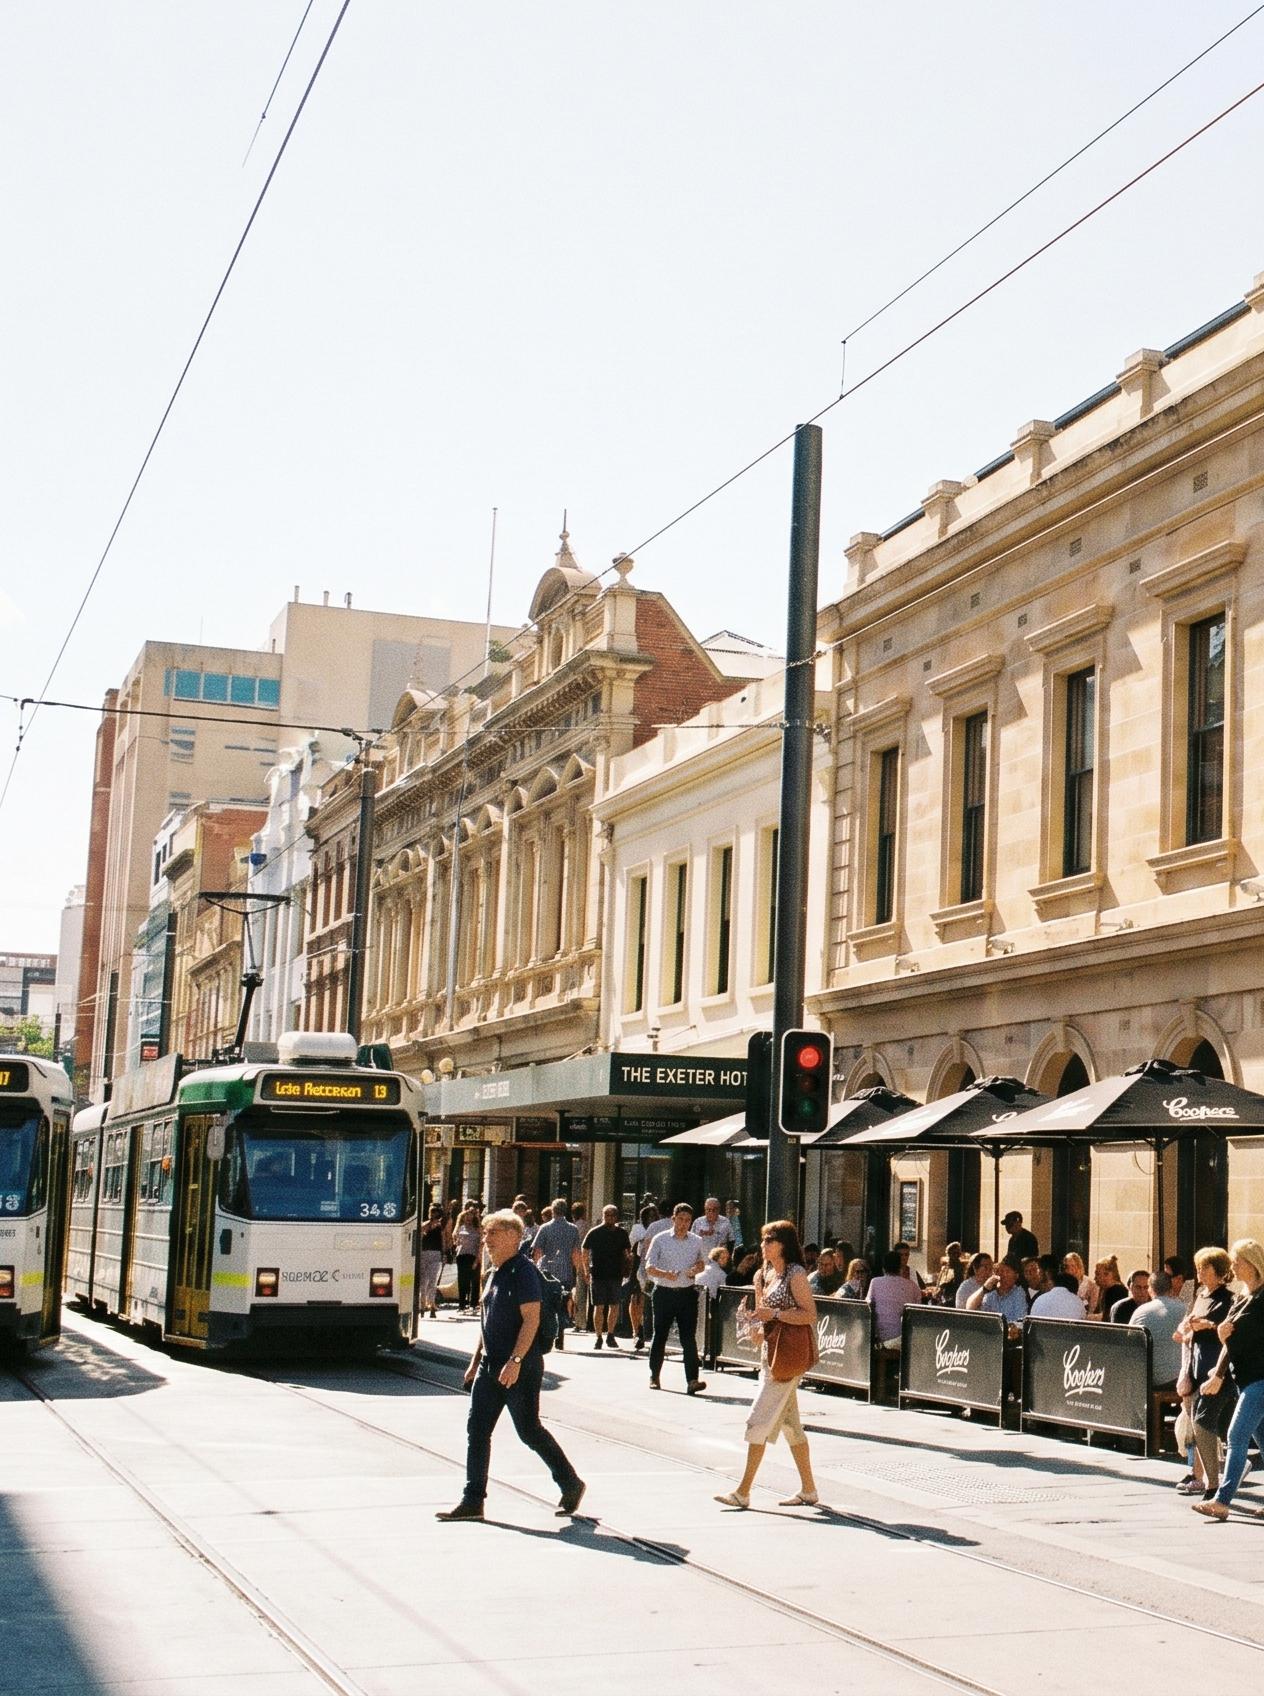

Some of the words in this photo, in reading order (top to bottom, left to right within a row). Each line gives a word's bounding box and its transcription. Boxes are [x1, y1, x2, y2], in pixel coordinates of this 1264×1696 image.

[621, 1066, 651, 1083] THE
[656, 1067, 715, 1085] EXETER
[720, 1070, 748, 1086] HOT
